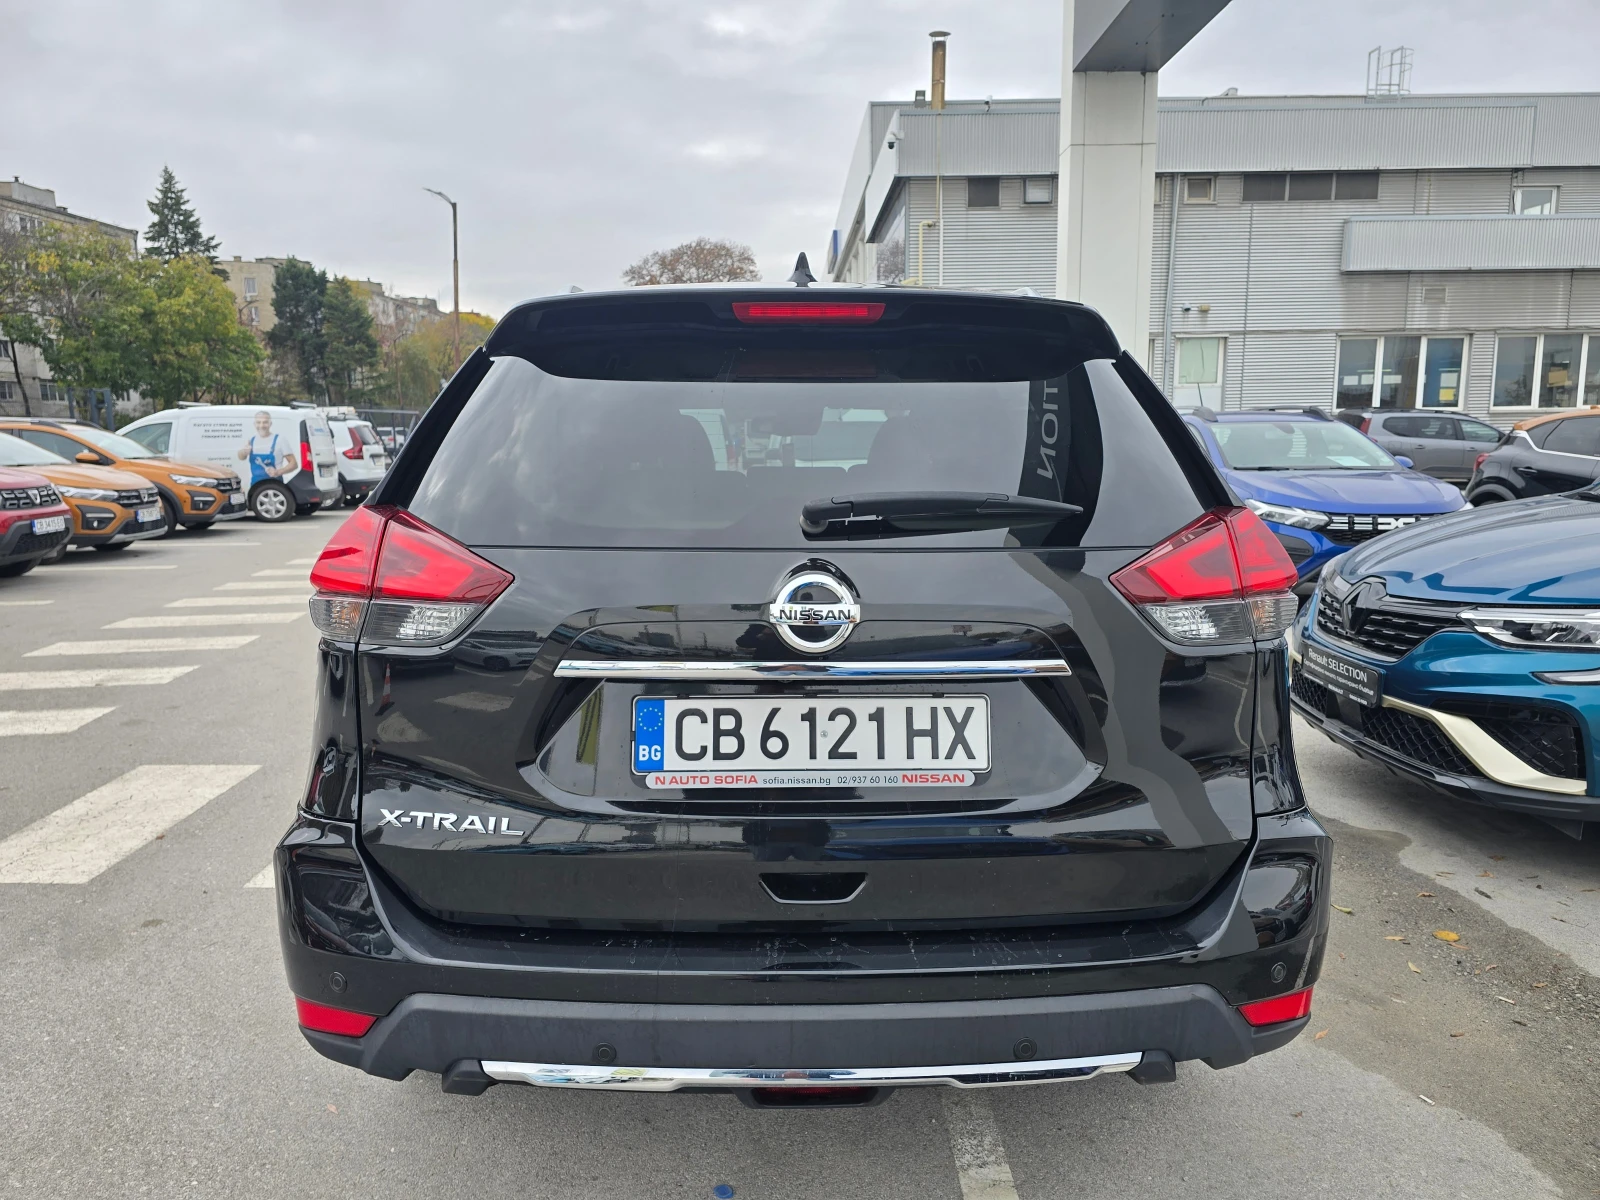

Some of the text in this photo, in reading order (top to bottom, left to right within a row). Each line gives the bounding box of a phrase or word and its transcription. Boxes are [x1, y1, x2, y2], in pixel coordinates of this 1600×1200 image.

[779, 609, 851, 621] NISSAN
[1308, 648, 1328, 667] Renault
[1328, 658, 1368, 683] SELECTION
[675, 706, 977, 761] CB 6121 HX
[638, 745, 661, 760] BG
[654, 774, 965, 786] N AUTO SOFIA sofia.nissan.bg 02/937 60 160 NISSAN
[377, 808, 526, 836] X-TRAIL
